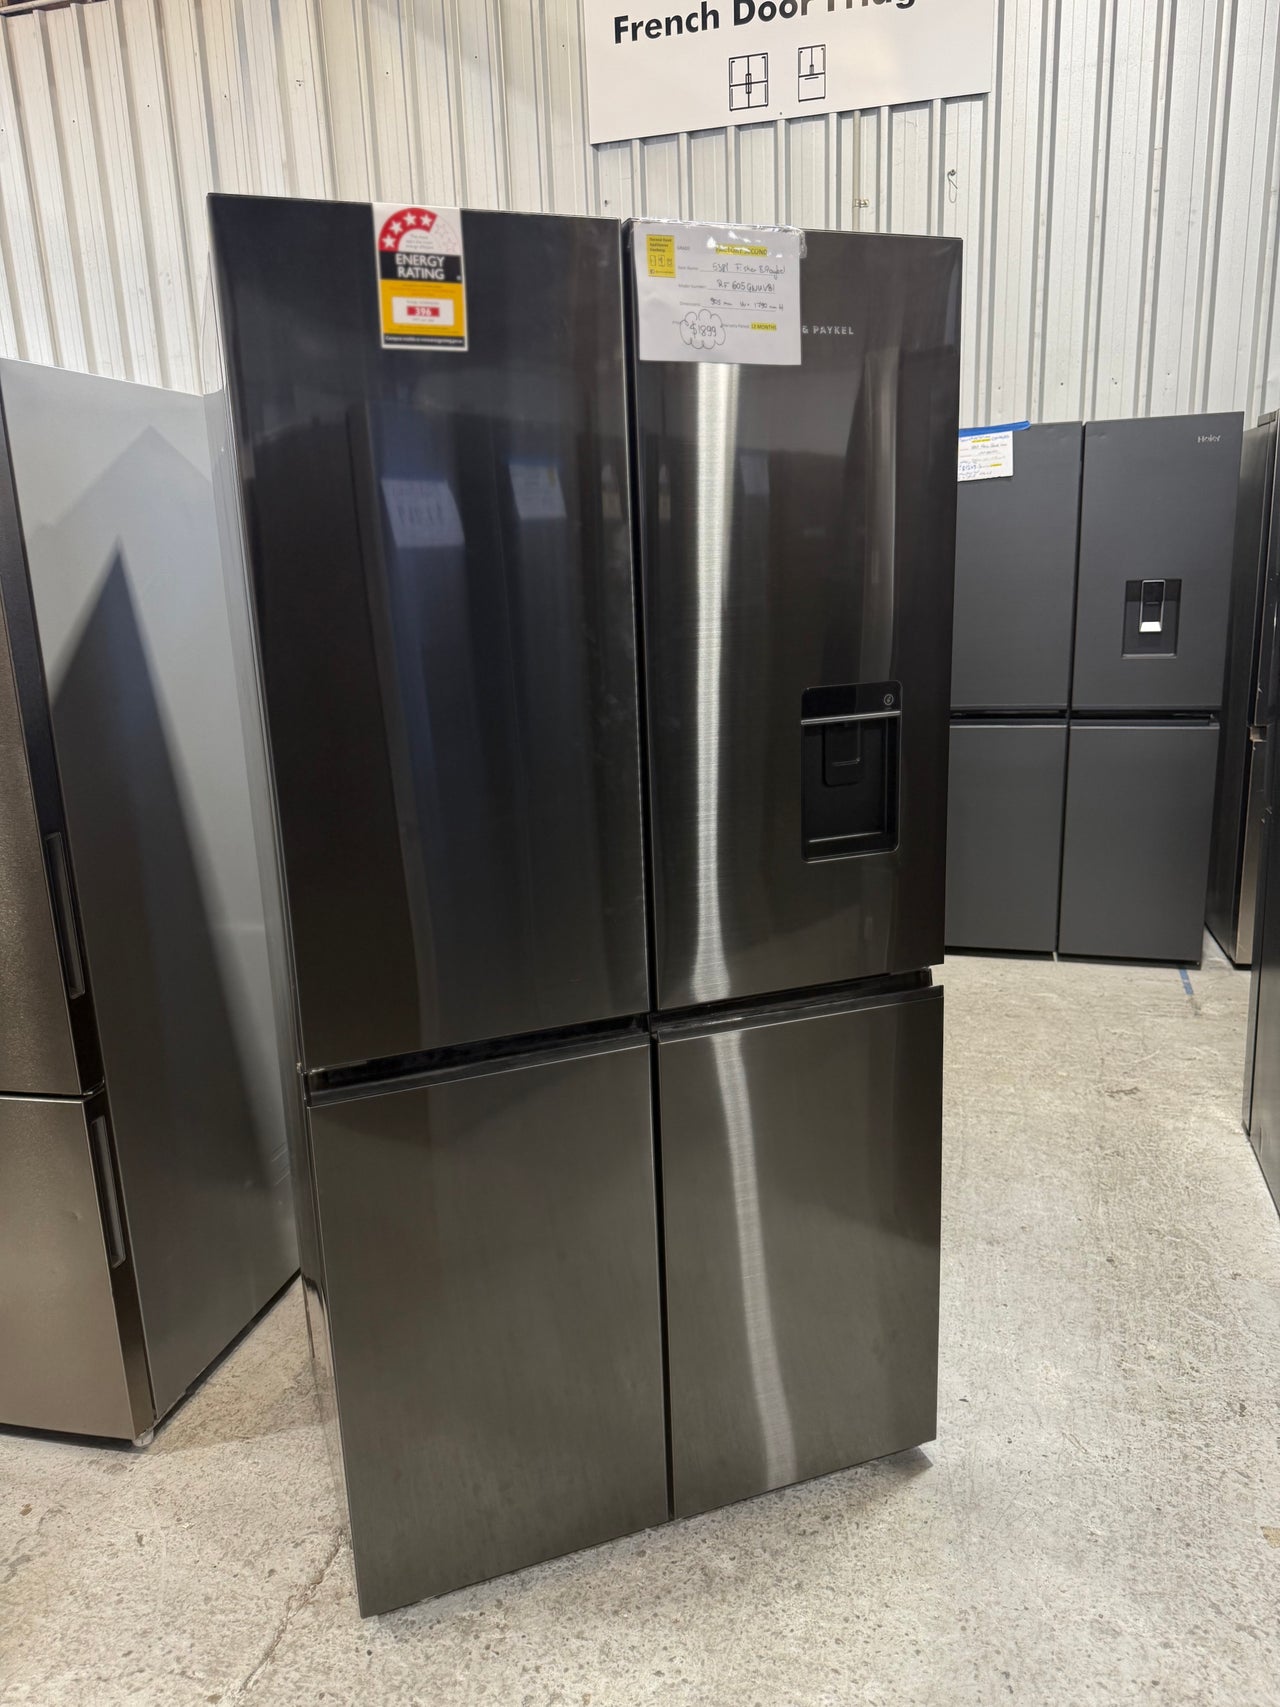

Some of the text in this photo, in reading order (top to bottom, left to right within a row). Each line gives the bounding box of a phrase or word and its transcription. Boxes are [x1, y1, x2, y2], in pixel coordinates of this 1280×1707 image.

[614, 0, 813, 44] French Door
[395, 253, 445, 267] ENERGY
[397, 266, 445, 280] RATING
[415, 307, 432, 316] 396
[690, 321, 717, 339] $1899
[757, 323, 777, 331] MONTHS
[812, 325, 854, 335] PAYKEL
